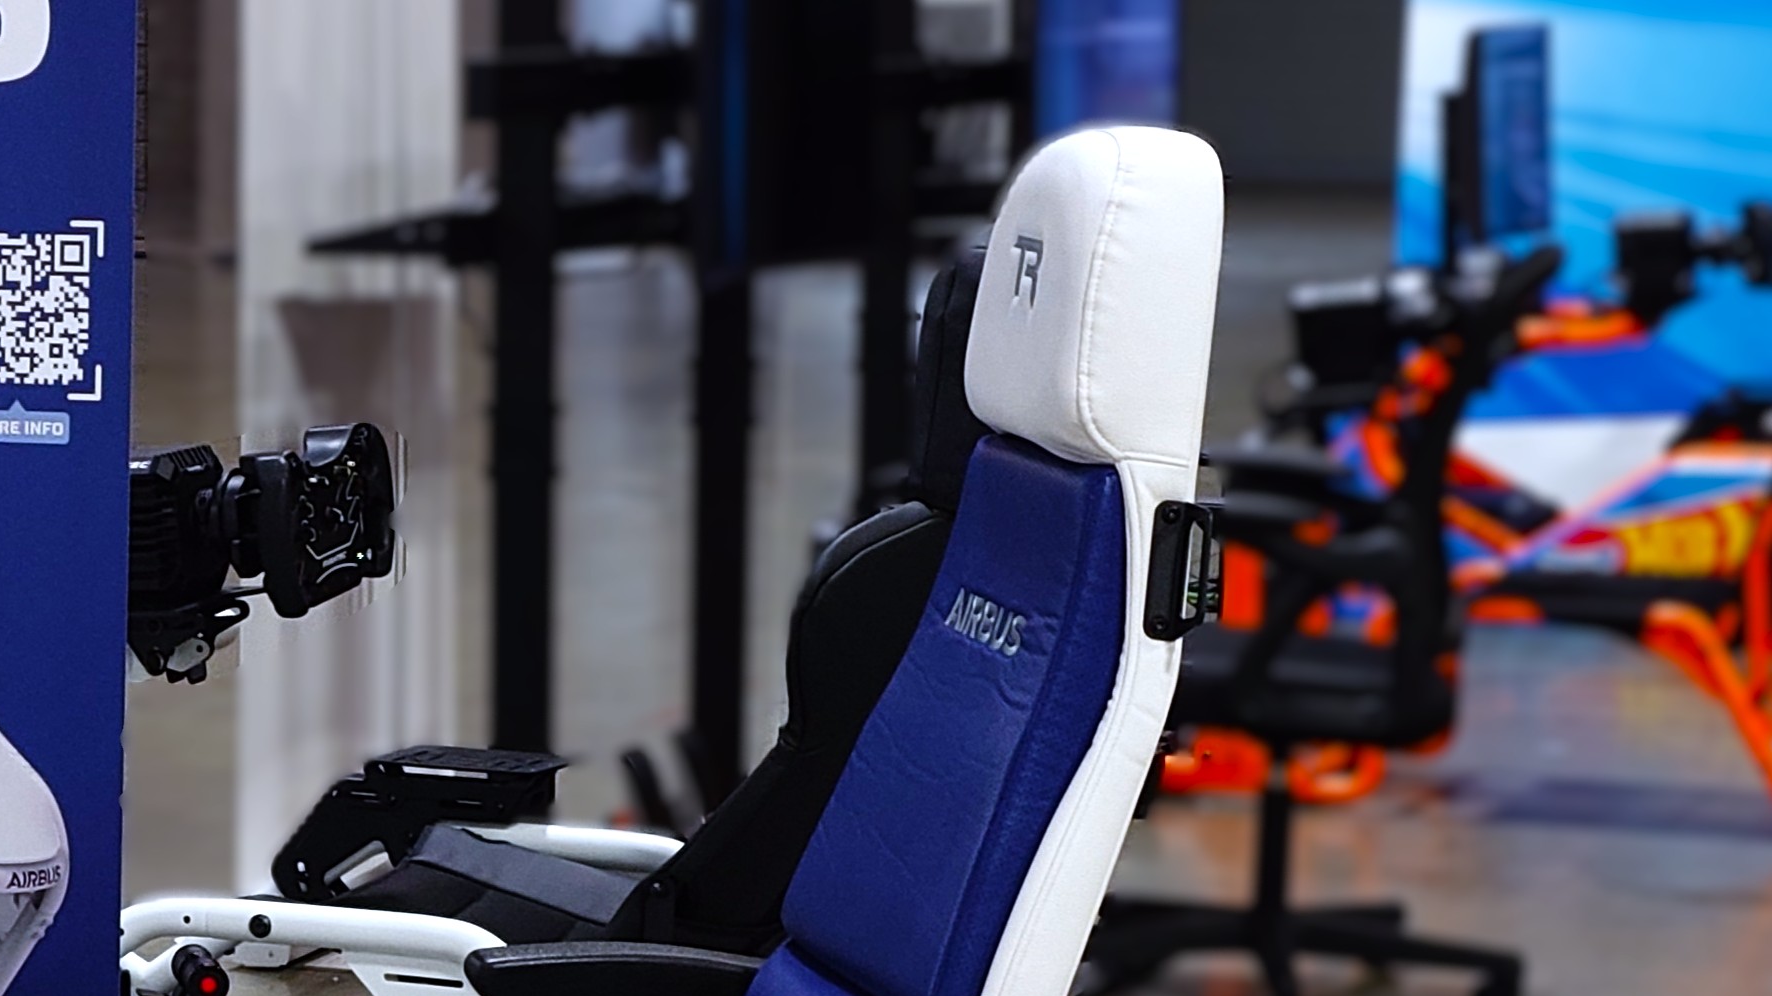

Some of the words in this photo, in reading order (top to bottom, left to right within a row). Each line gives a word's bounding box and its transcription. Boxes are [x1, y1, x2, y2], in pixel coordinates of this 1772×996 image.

[24, 420, 64, 436] INFO
[944, 587, 1027, 656] AIRBUS
[6, 864, 61, 889] AIRBUS
